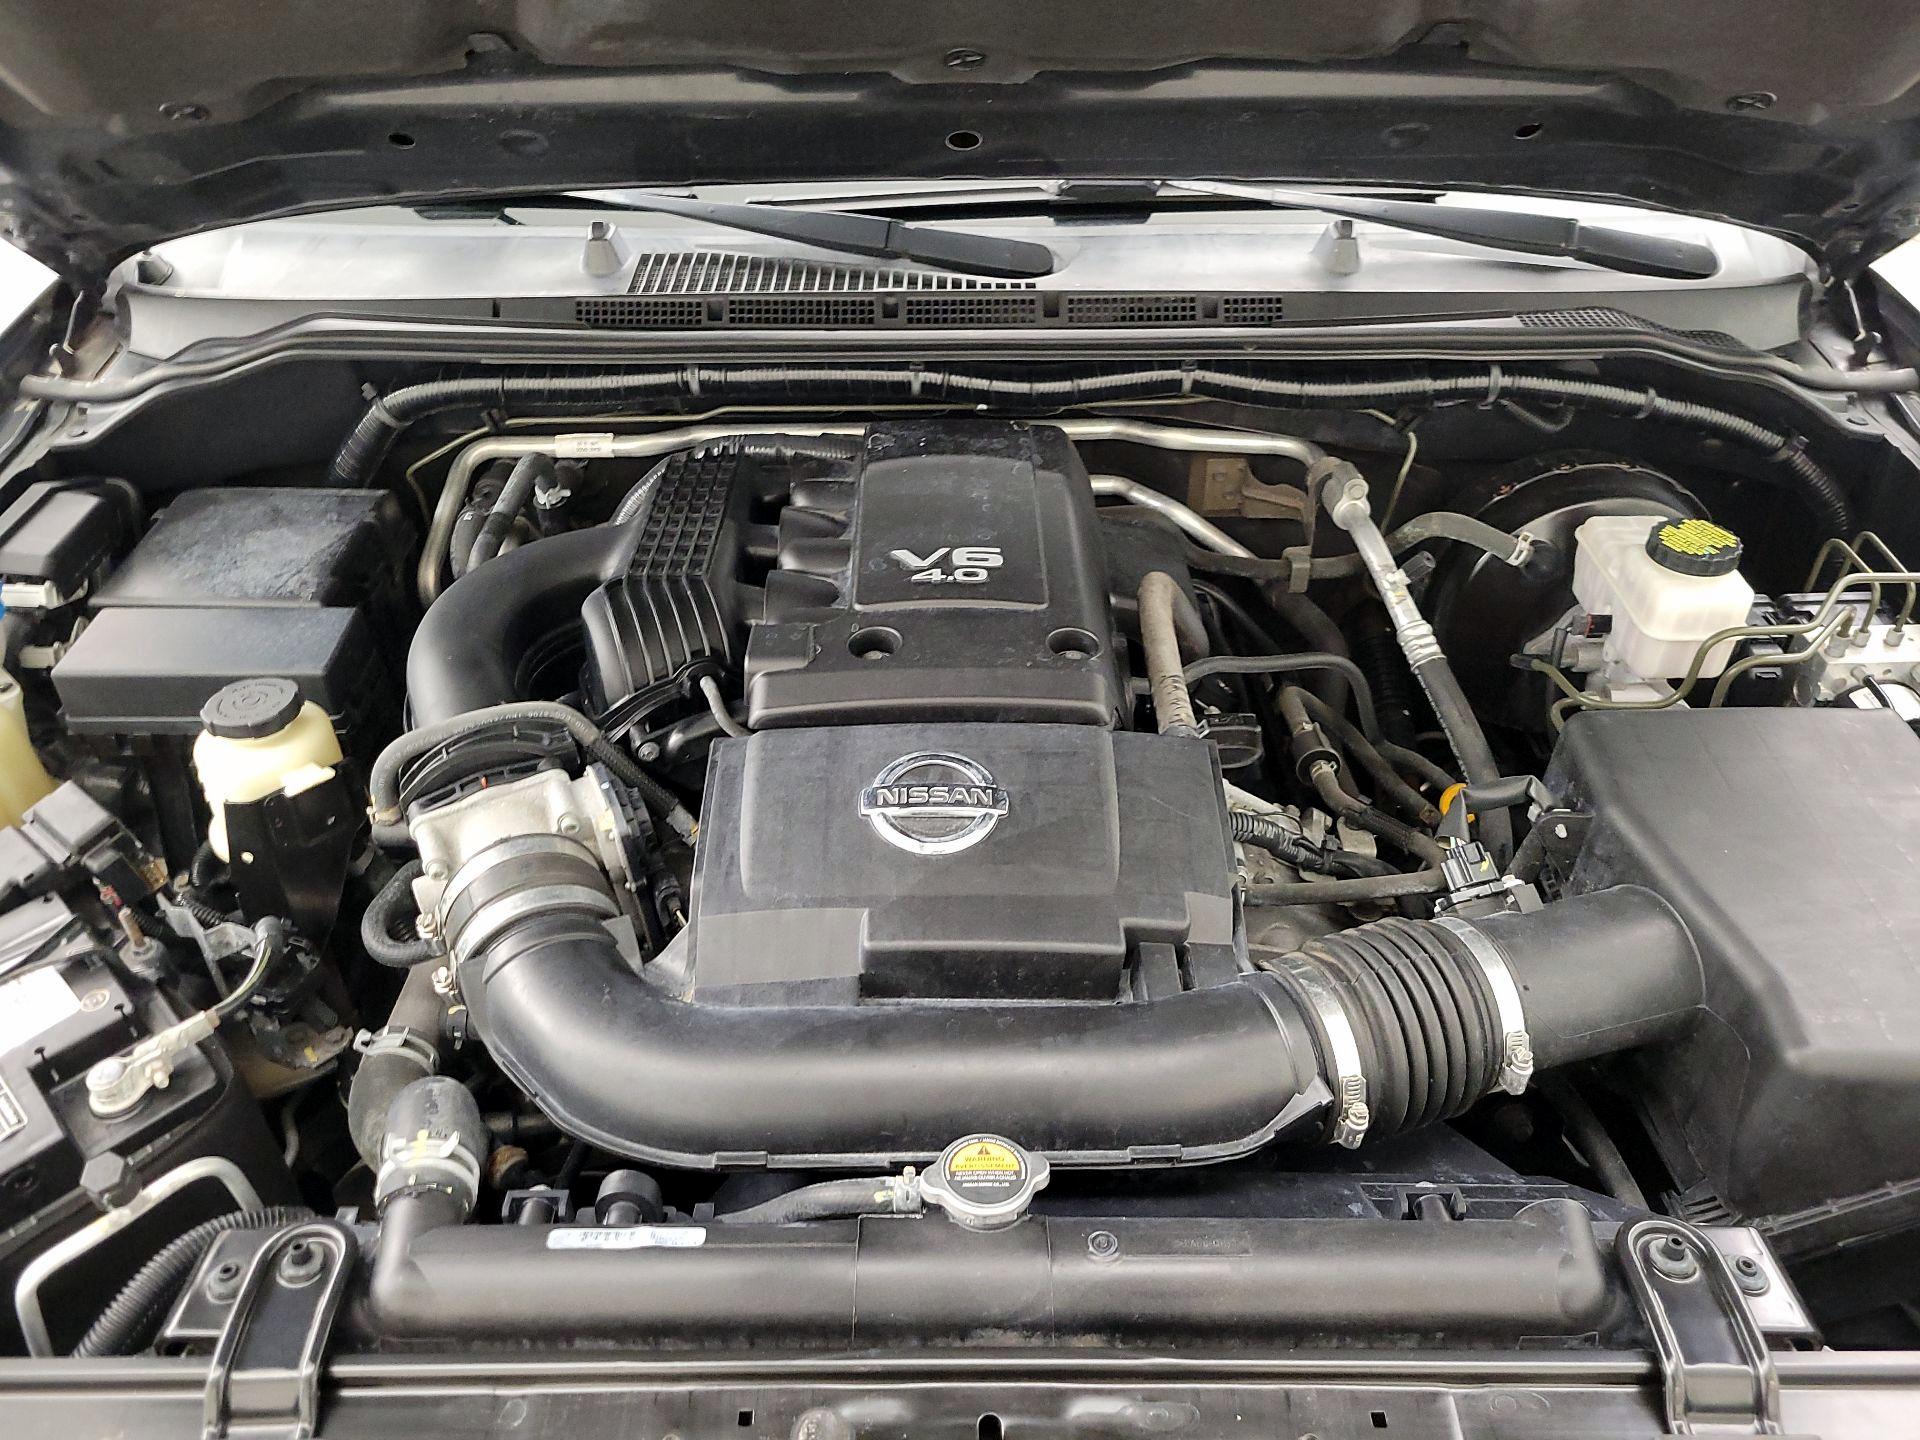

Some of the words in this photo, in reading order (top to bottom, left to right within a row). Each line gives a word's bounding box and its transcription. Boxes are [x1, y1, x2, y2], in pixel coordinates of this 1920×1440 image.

[890, 547, 1004, 570] V6
[910, 568, 988, 584] 4.0
[876, 786, 993, 806] NISSAN
